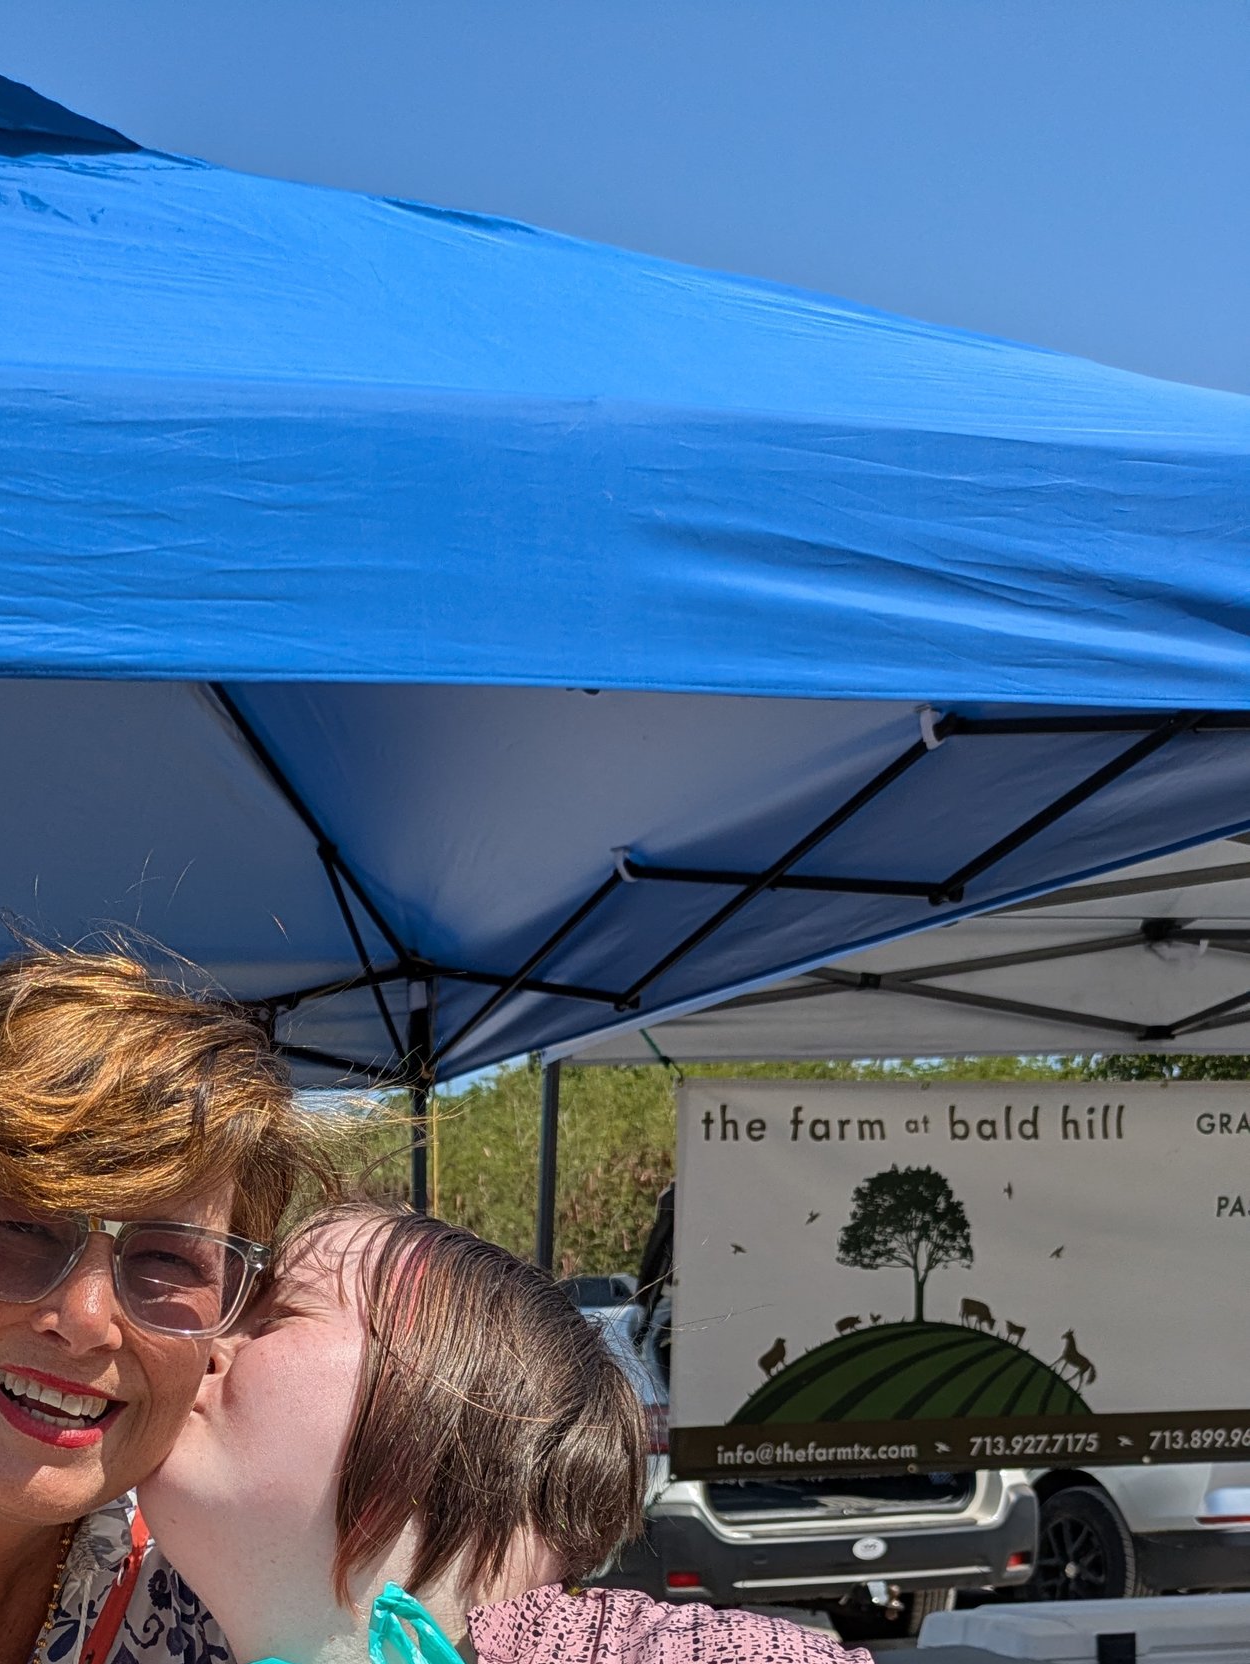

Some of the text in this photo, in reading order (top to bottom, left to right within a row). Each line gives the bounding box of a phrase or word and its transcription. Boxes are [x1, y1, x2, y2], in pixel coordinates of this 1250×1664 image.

[701, 1104, 1126, 1142] the farm at bald hill
[1216, 1195, 1250, 1218] PA
[716, 1441, 919, 1466] info@thefarmtx.com
[969, 1432, 1100, 1457] 713.927.7175
